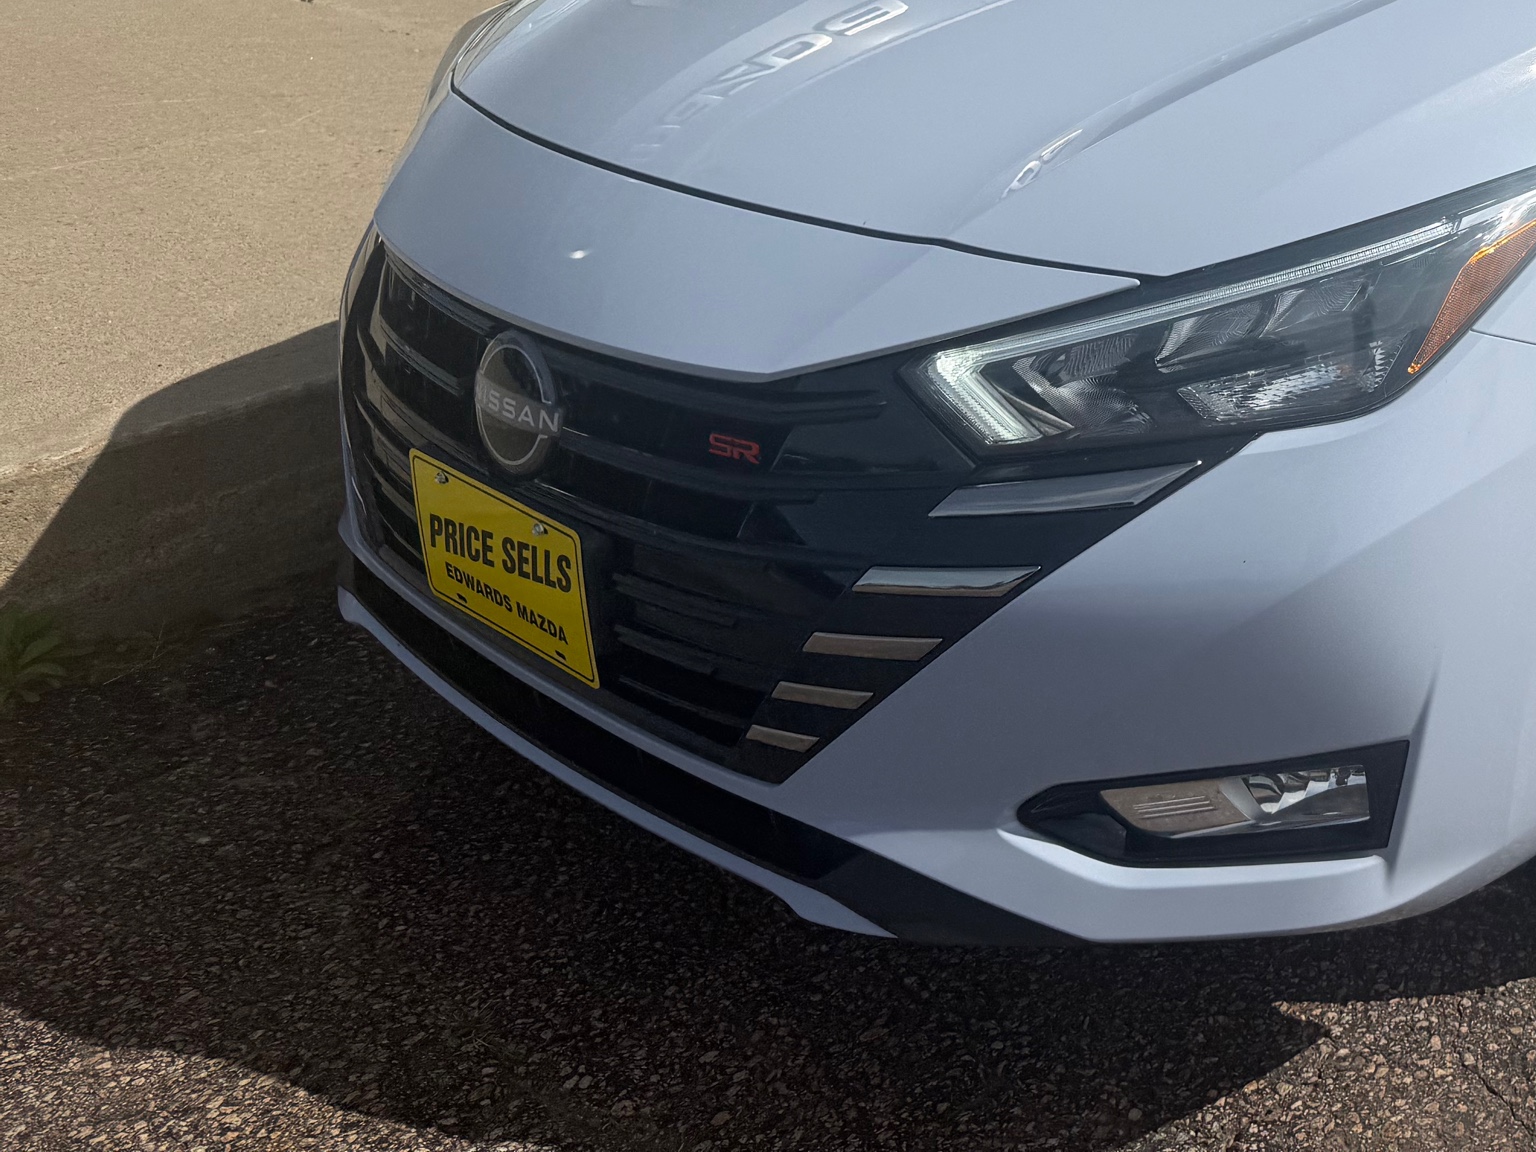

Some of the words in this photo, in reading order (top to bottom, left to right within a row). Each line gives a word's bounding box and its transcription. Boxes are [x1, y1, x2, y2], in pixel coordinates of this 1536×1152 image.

[476, 382, 560, 433] NISSAN
[708, 433, 761, 464] SR
[429, 513, 495, 568] PRICE
[501, 537, 572, 593] SELLS
[445, 561, 513, 612] EDWARDS
[516, 601, 569, 645] MAZDA
